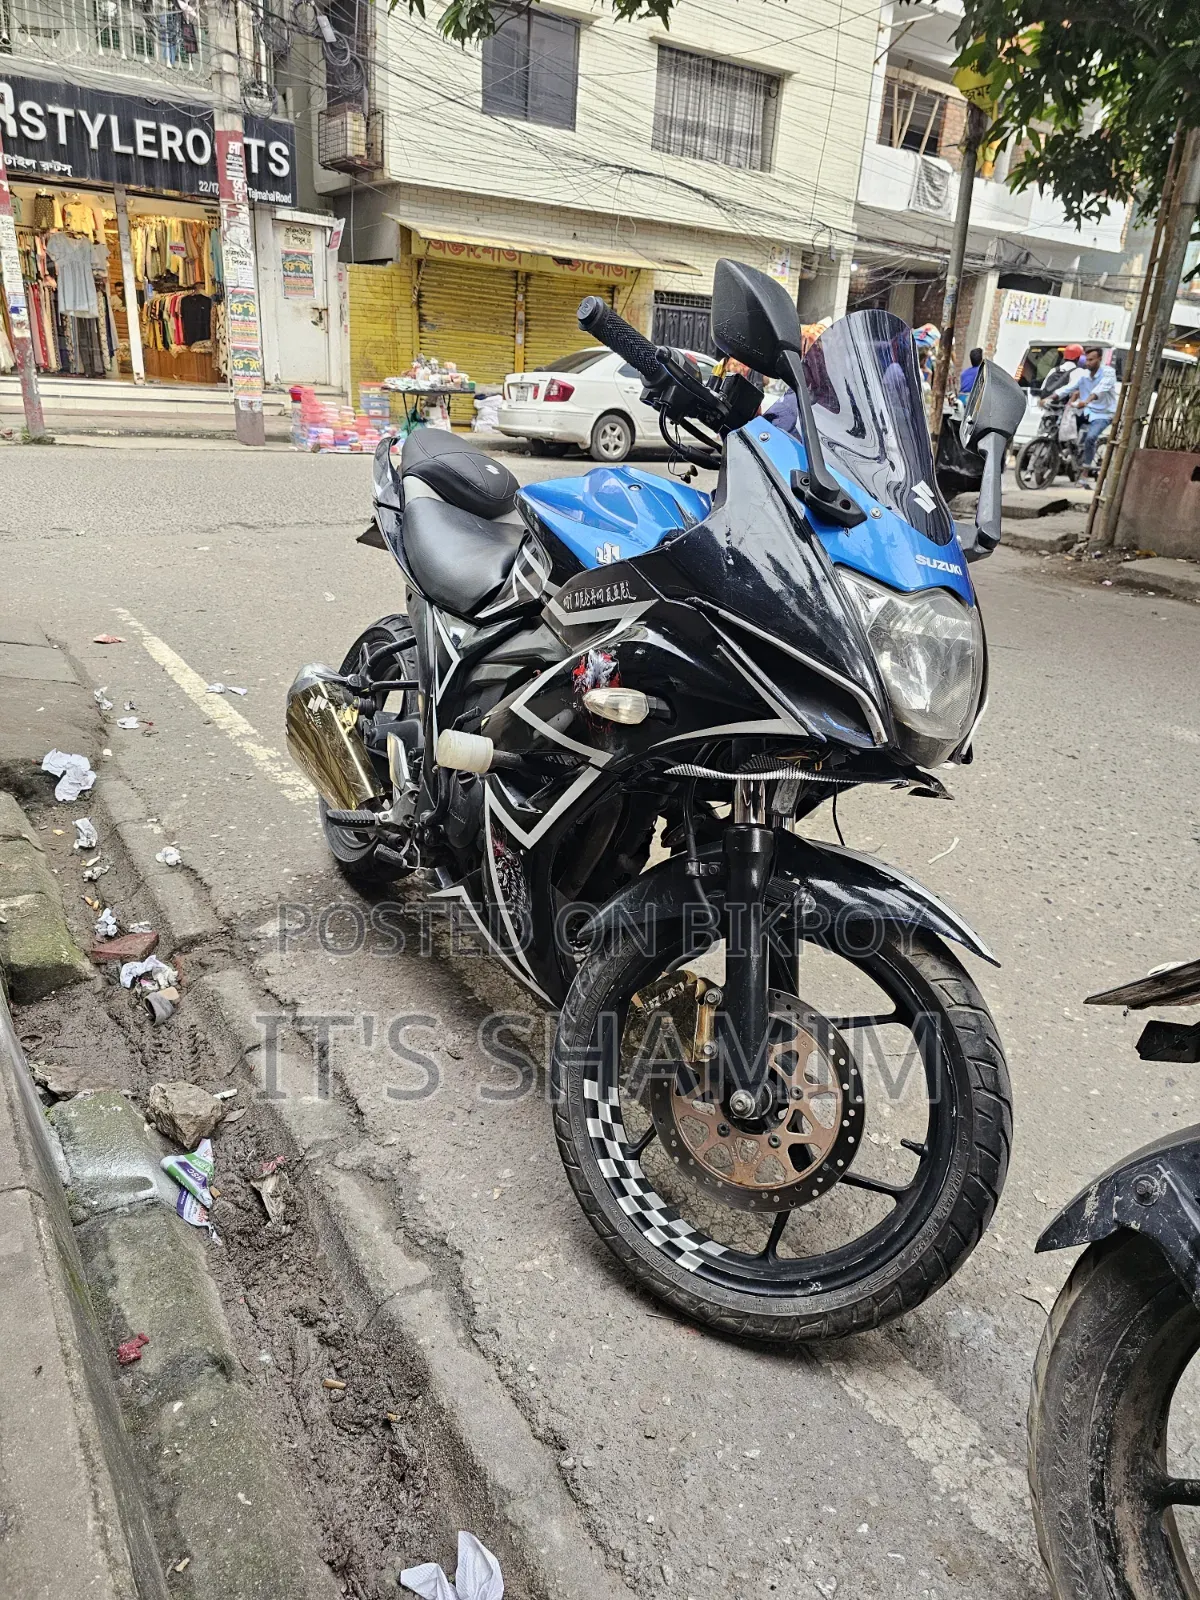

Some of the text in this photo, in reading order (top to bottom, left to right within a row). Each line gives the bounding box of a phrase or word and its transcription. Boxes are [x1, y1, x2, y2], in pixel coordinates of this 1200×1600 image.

[19, 100, 290, 178] STYLEROTS
[248, 187, 275, 203] Tajmahal
[275, 190, 292, 204] Road
[915, 554, 963, 576] SUZUKI
[187, 1167, 204, 1182] HSC
